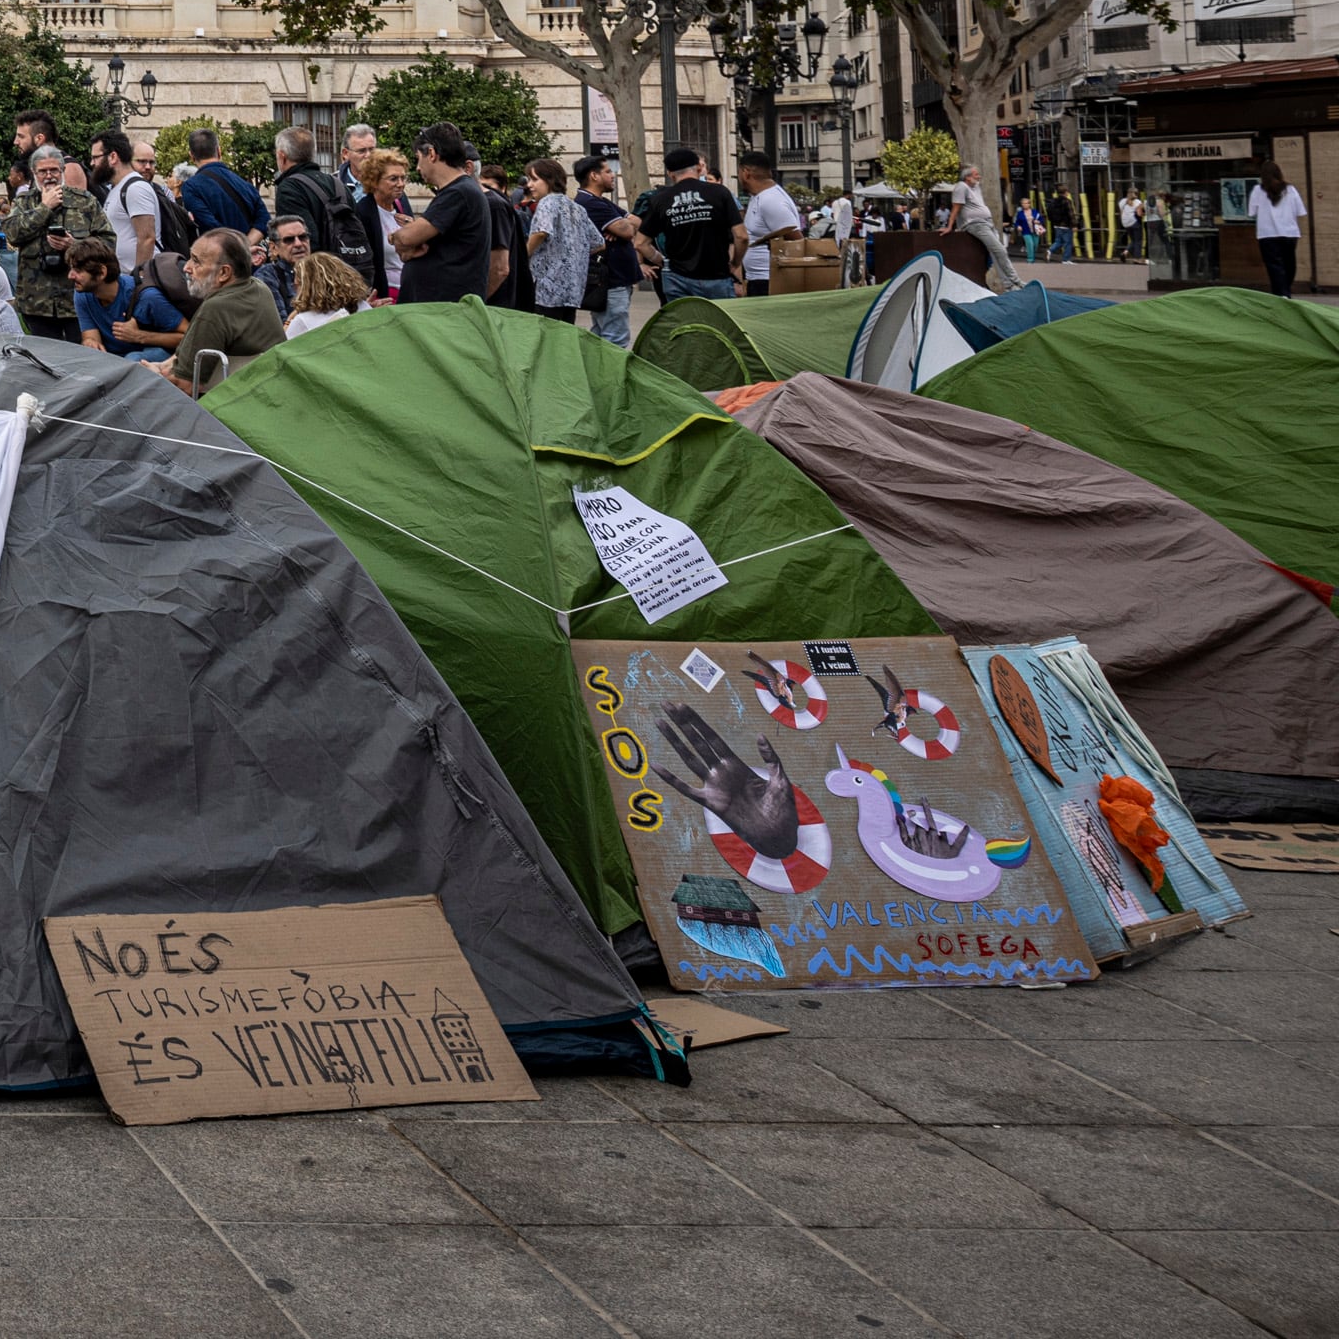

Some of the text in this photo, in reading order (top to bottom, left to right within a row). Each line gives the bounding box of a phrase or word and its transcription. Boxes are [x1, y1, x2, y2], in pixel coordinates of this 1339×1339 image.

[1167, 143, 1222, 159] MONTAÑANA
[585, 516, 648, 542] PISO PARA
[639, 522, 663, 539] CON
[606, 534, 669, 572] ESTA ZONA
[820, 645, 849, 654] turista
[585, 665, 664, 833] SOS
[71, 919, 233, 984] NO ÉS
[916, 932, 1041, 962] S'OFEGA
[94, 968, 417, 1024] TURISMEFÒBIA
[119, 1031, 204, 1086] ÉS
